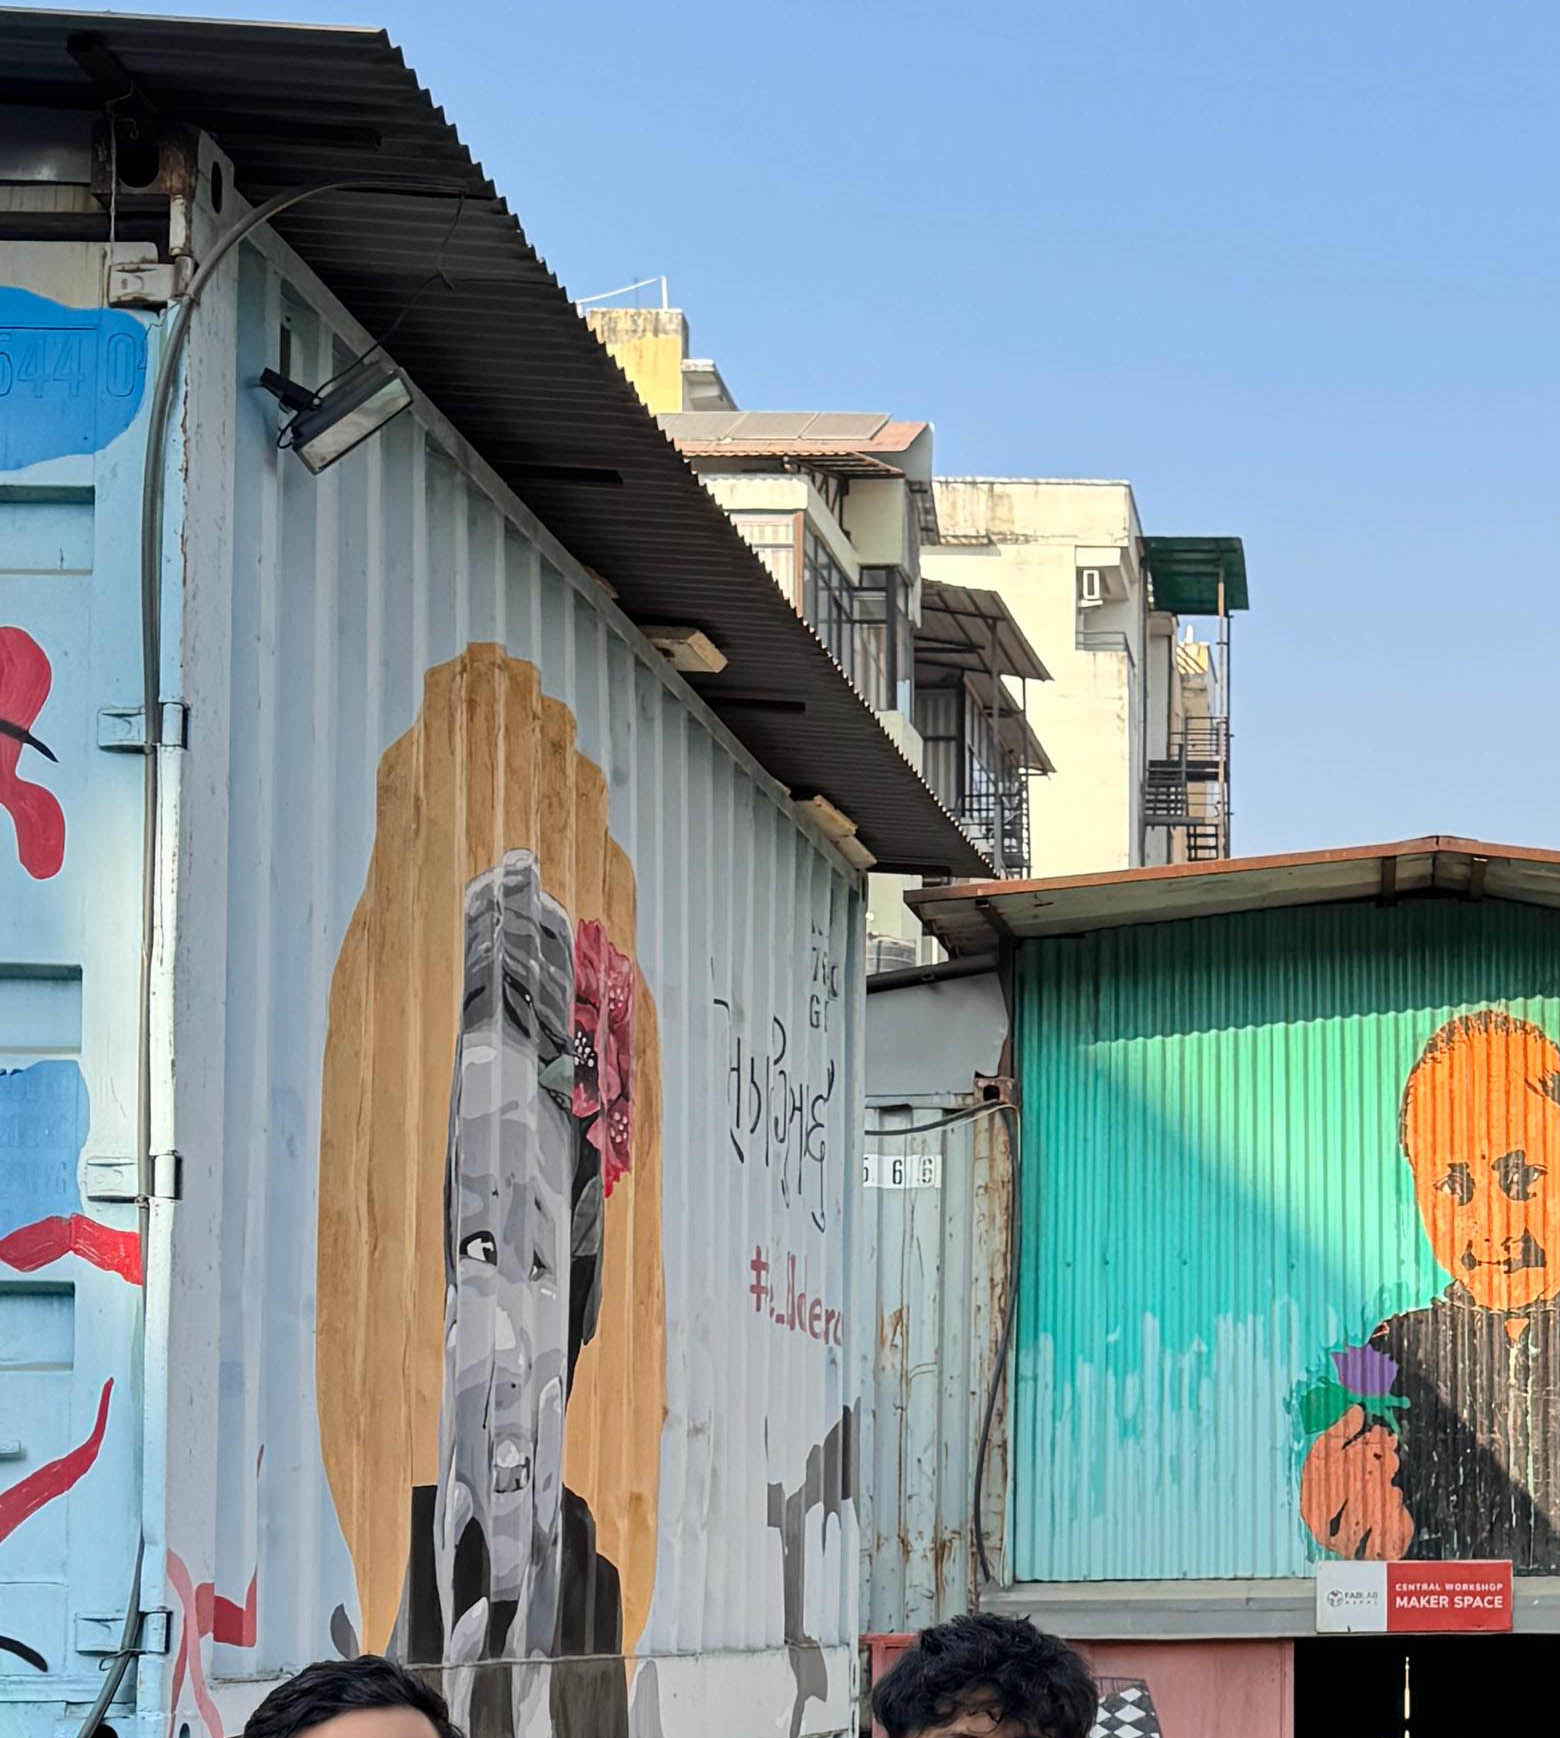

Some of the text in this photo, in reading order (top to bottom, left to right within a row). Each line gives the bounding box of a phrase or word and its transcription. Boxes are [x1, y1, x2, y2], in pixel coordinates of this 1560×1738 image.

[1395, 1583, 1504, 1591] CENTRAL WORKSHOP
[1395, 1596, 1504, 1609] MAKER SPACE
